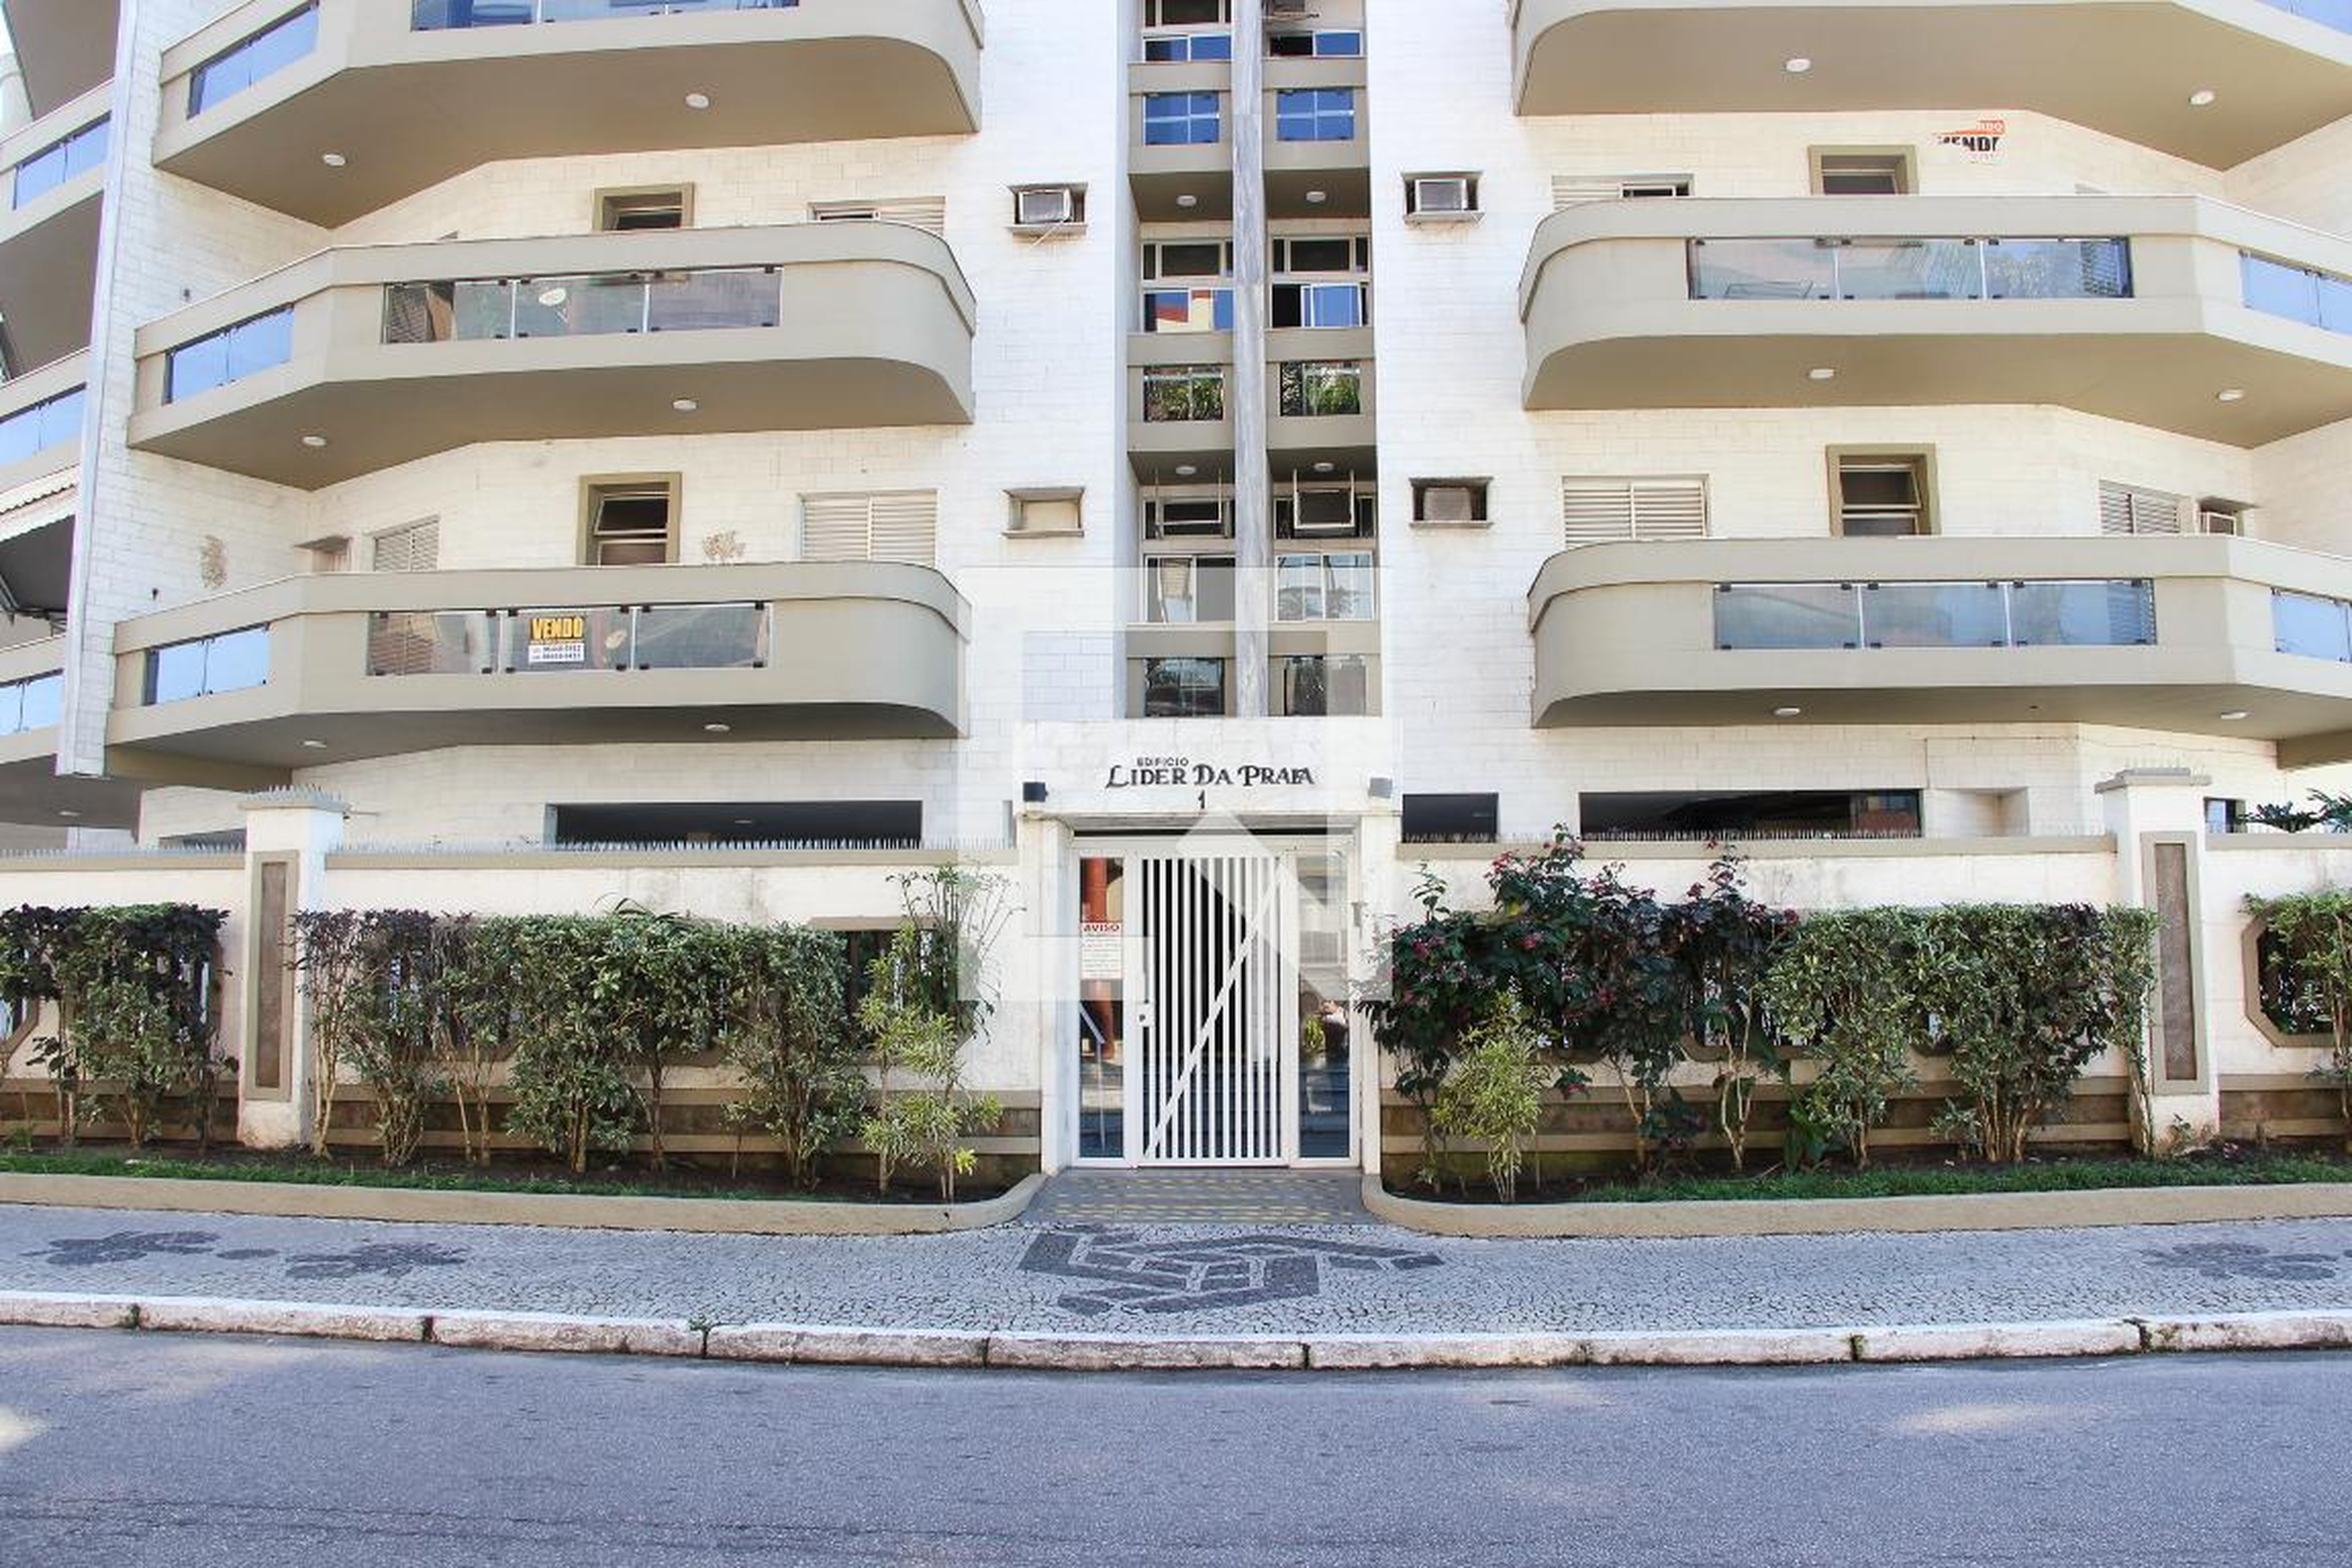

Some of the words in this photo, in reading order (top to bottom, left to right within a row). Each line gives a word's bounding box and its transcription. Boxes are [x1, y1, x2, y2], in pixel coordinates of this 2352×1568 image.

[532, 617, 583, 639] VENDO
[1105, 764, 1187, 788] LIDER
[1193, 763, 1233, 785] DA
